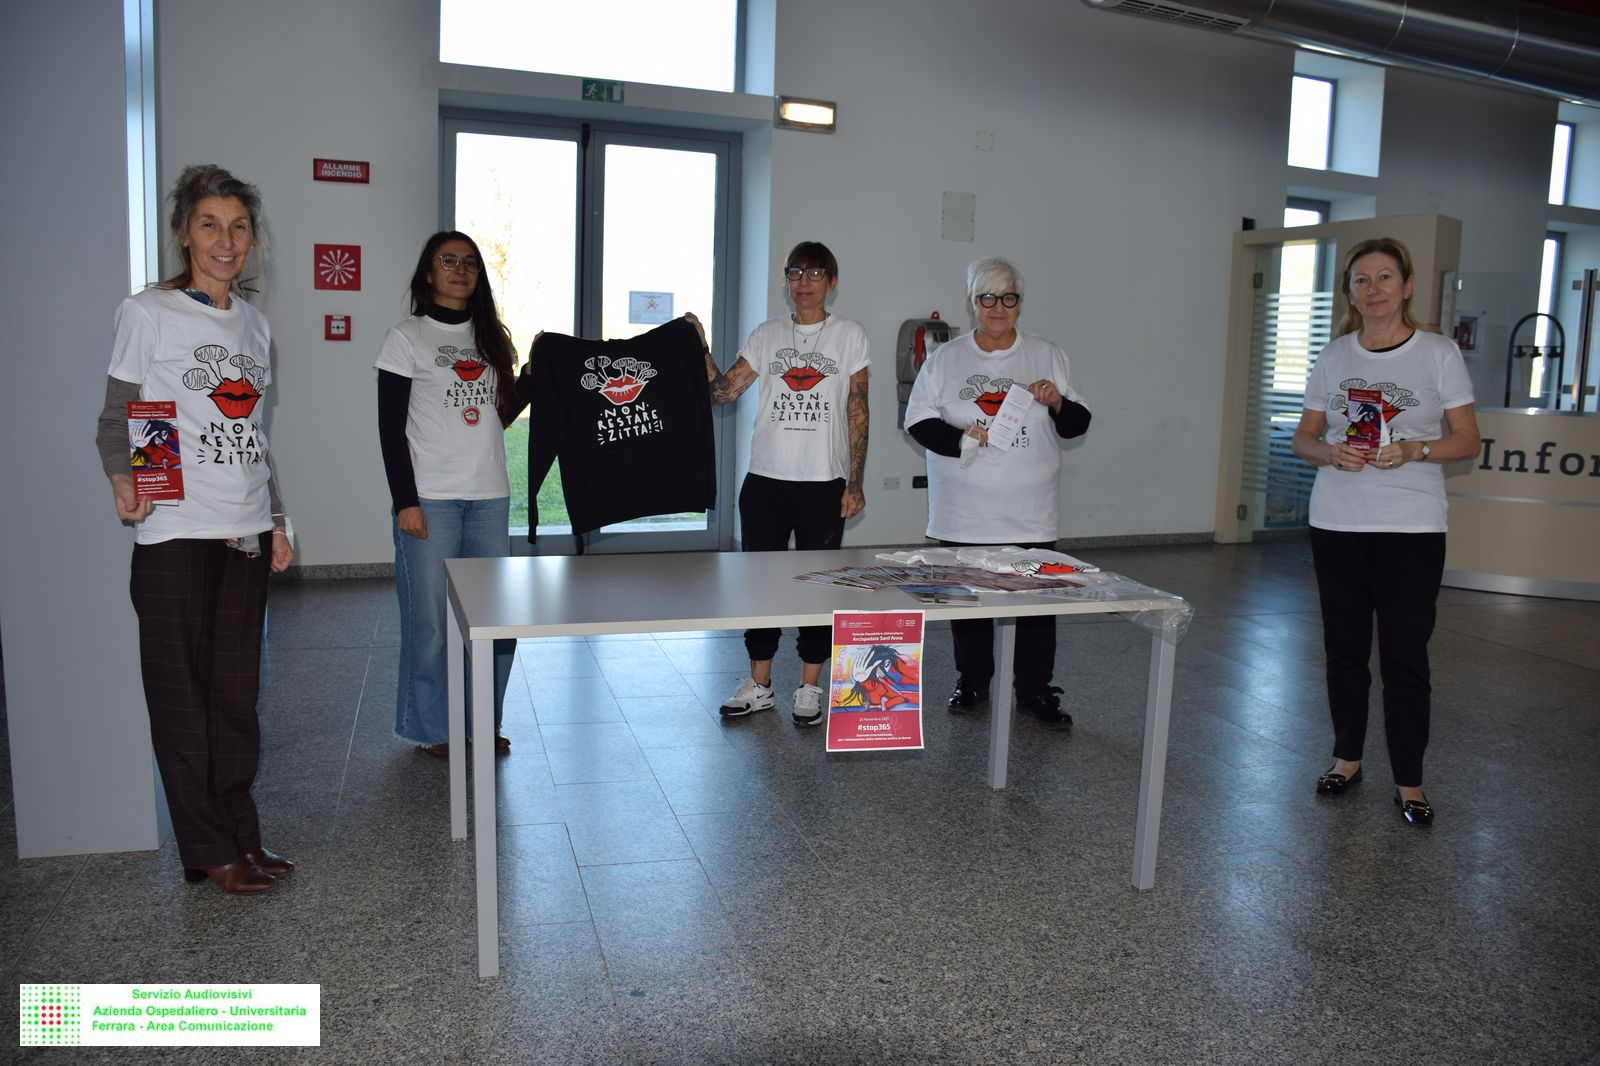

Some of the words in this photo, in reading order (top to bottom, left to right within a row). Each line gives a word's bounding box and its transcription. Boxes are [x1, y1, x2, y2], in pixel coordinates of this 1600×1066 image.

[323, 163, 361, 171] ALLARME
[321, 169, 362, 178] INCENDIO
[455, 380, 486, 388] NON
[447, 387, 494, 397] RESTARE
[782, 392, 819, 401] NON
[605, 401, 646, 418] NON
[773, 401, 830, 411] RESTARE
[598, 409, 658, 430] RESTARE
[137, 475, 168, 483] #stop365
[857, 723, 891, 732] #stop365
